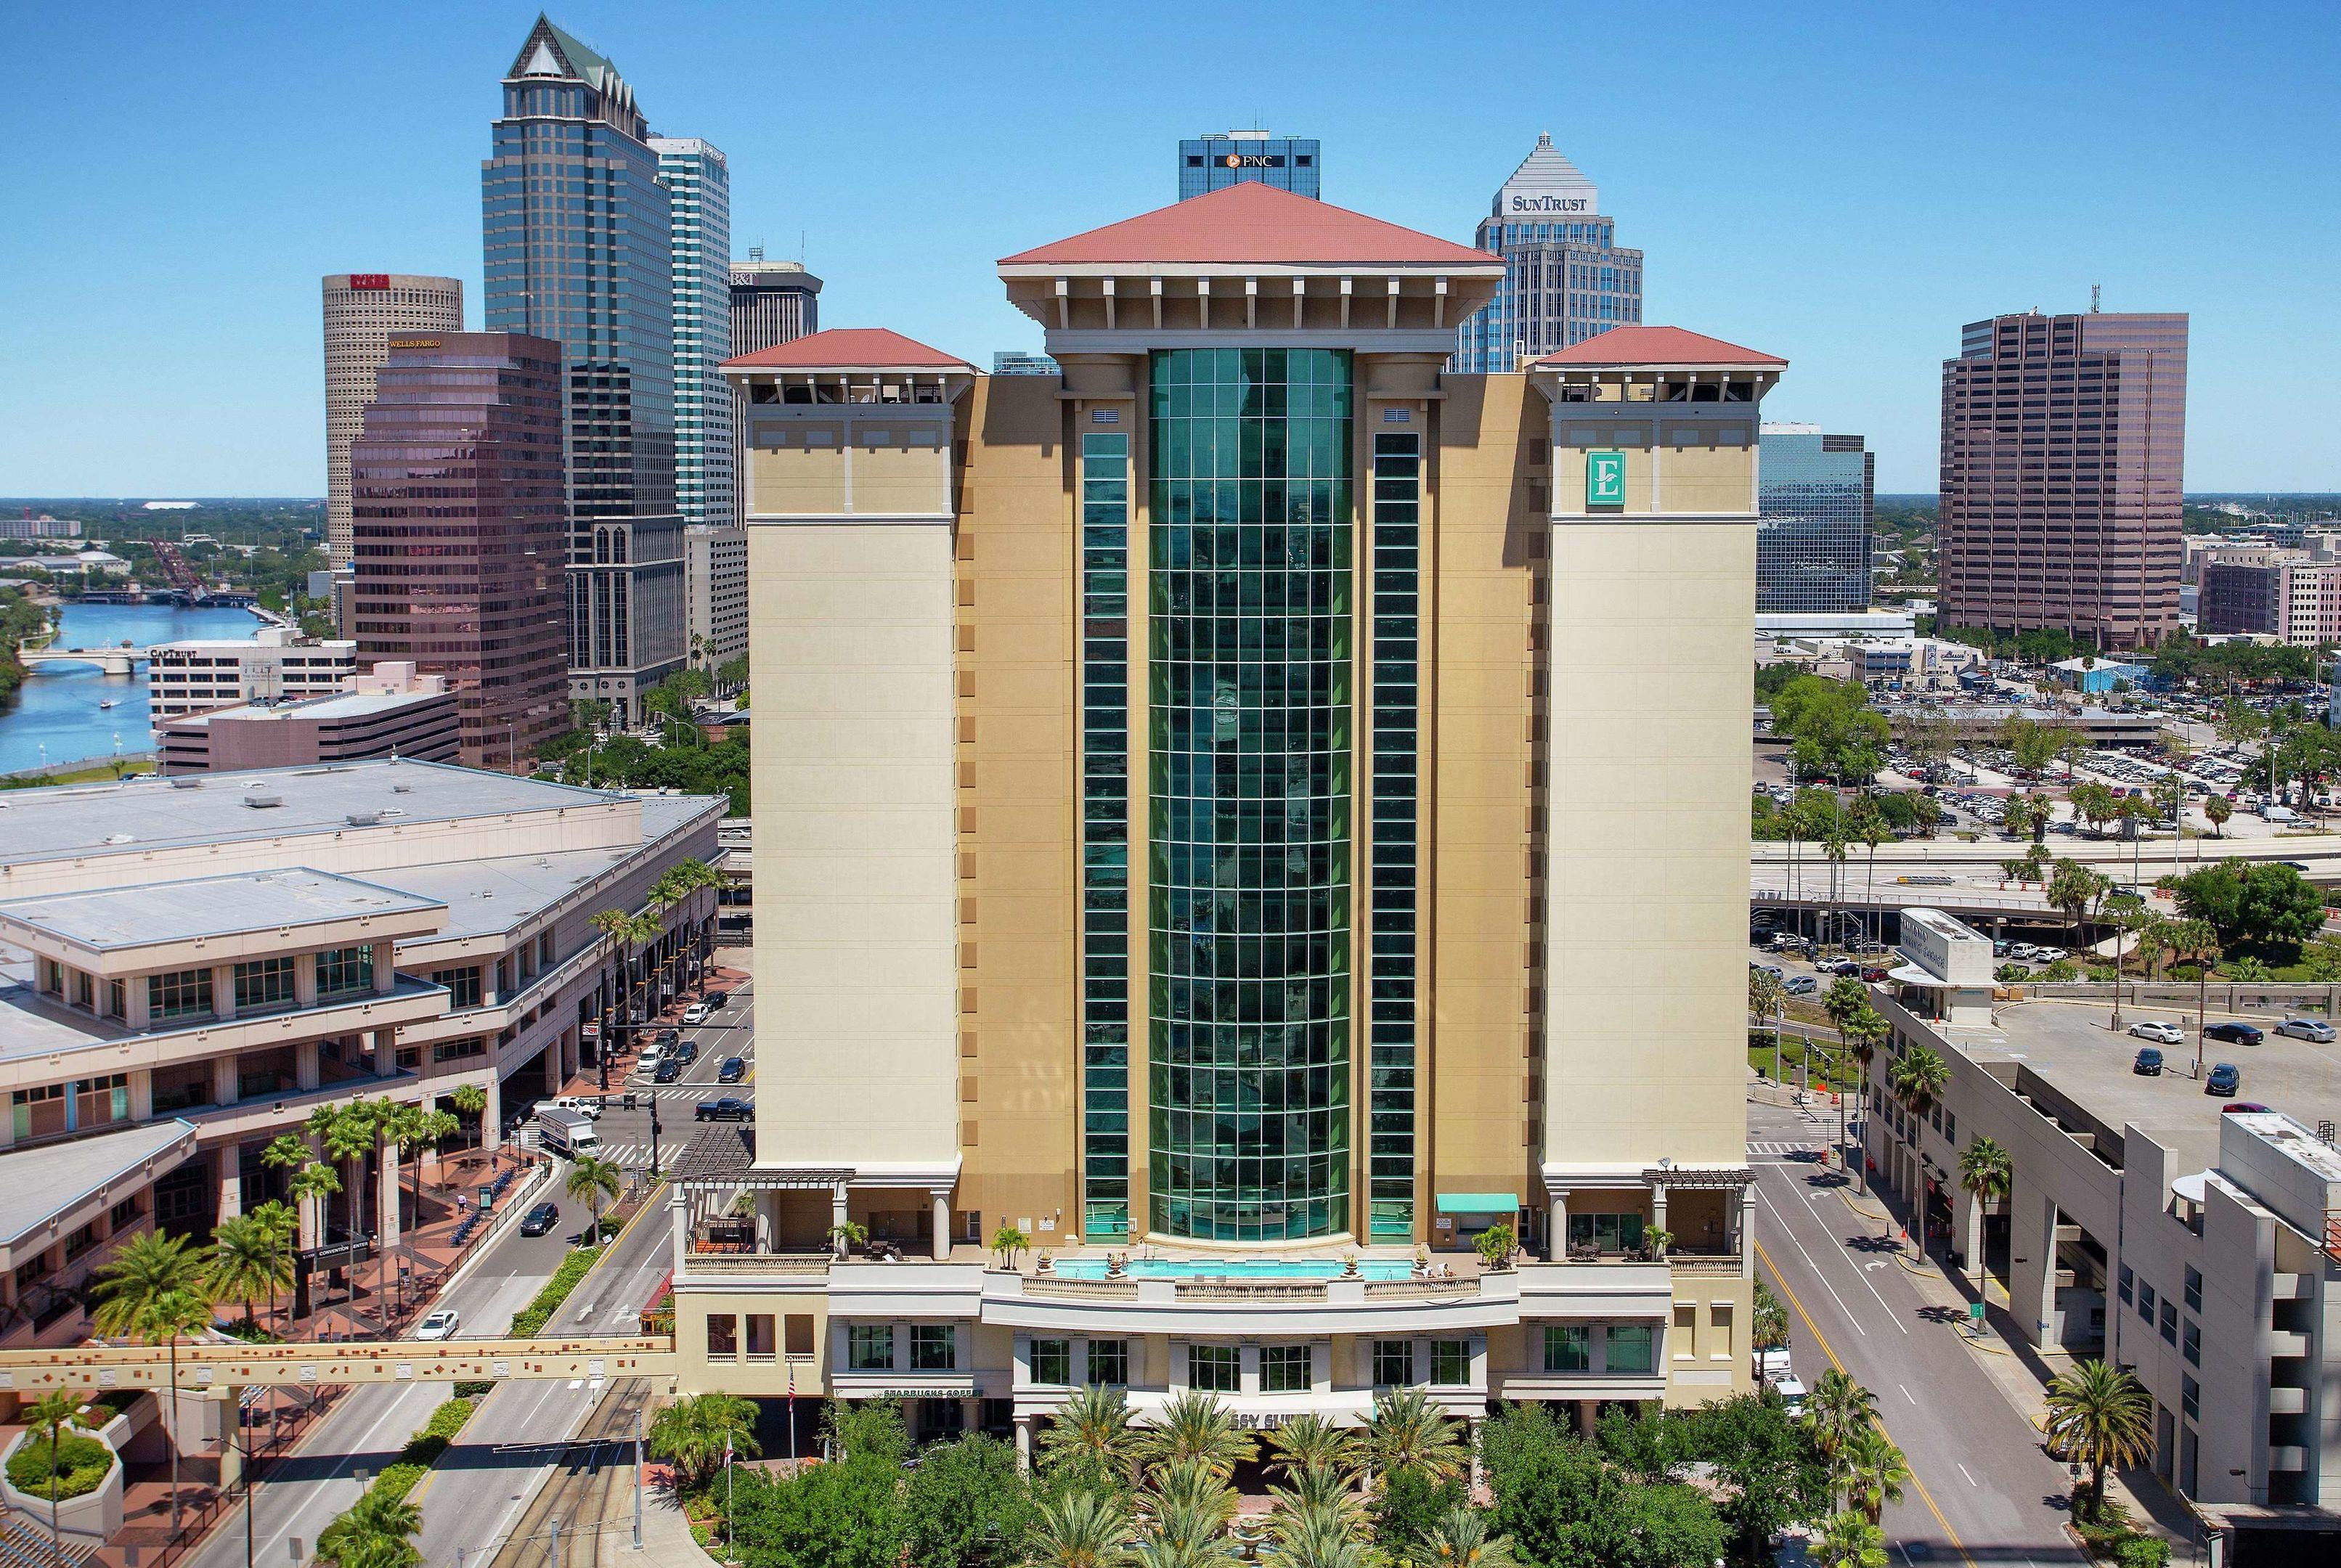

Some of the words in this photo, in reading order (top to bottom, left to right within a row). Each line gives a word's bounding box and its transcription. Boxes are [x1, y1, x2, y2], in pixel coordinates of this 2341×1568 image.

[1242, 155, 1272, 167] PNC
[1513, 195, 1587, 212] SUNTRUST
[1595, 460, 1619, 495] E
[150, 649, 197, 658] CAPTRUST
[319, 1246, 349, 1256] CONVENTION
